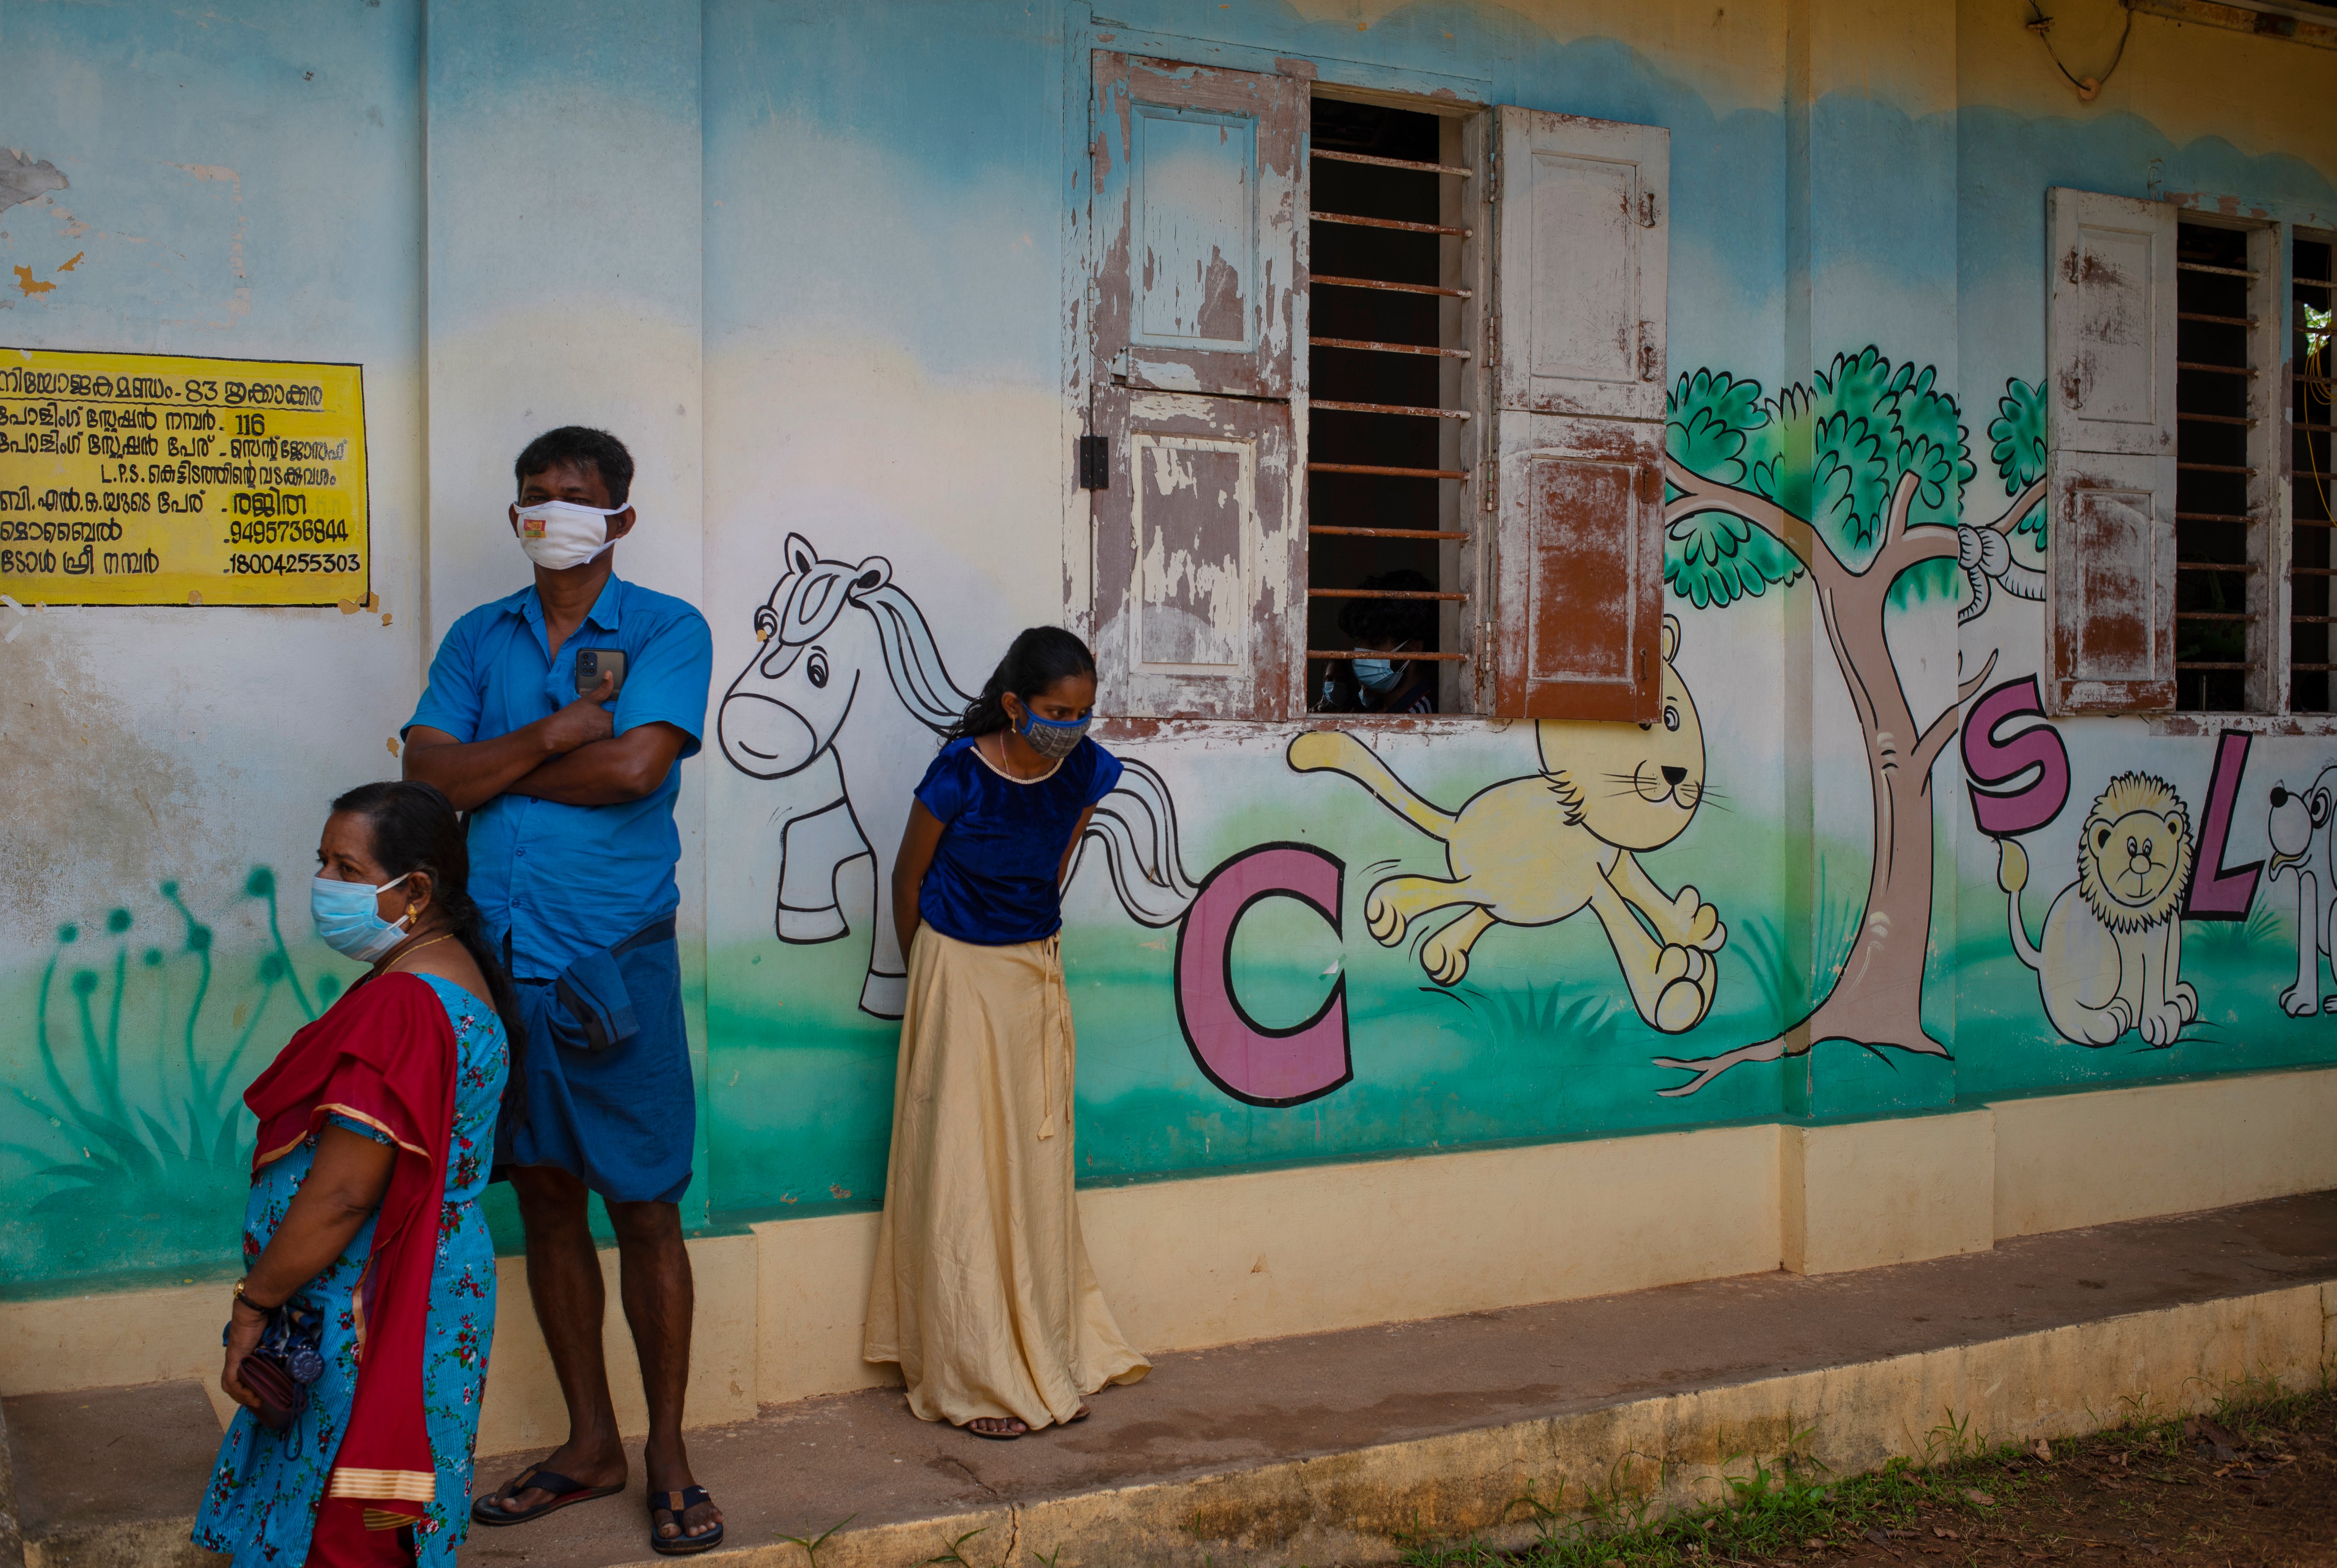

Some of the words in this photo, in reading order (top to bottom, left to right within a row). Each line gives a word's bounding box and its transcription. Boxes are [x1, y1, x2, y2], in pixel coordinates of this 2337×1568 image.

[235, 414, 264, 436] 116
[168, 435, 215, 457] പേര്
[101, 464, 144, 483] L.P.S.
[158, 490, 205, 514] പേര്
[0, 517, 122, 543] മൊബൈൽ
[1, 549, 56, 573] ടോൾ
[1960, 672, 2071, 837] S
[2180, 729, 2266, 921] L
[1174, 841, 1354, 1108] C
